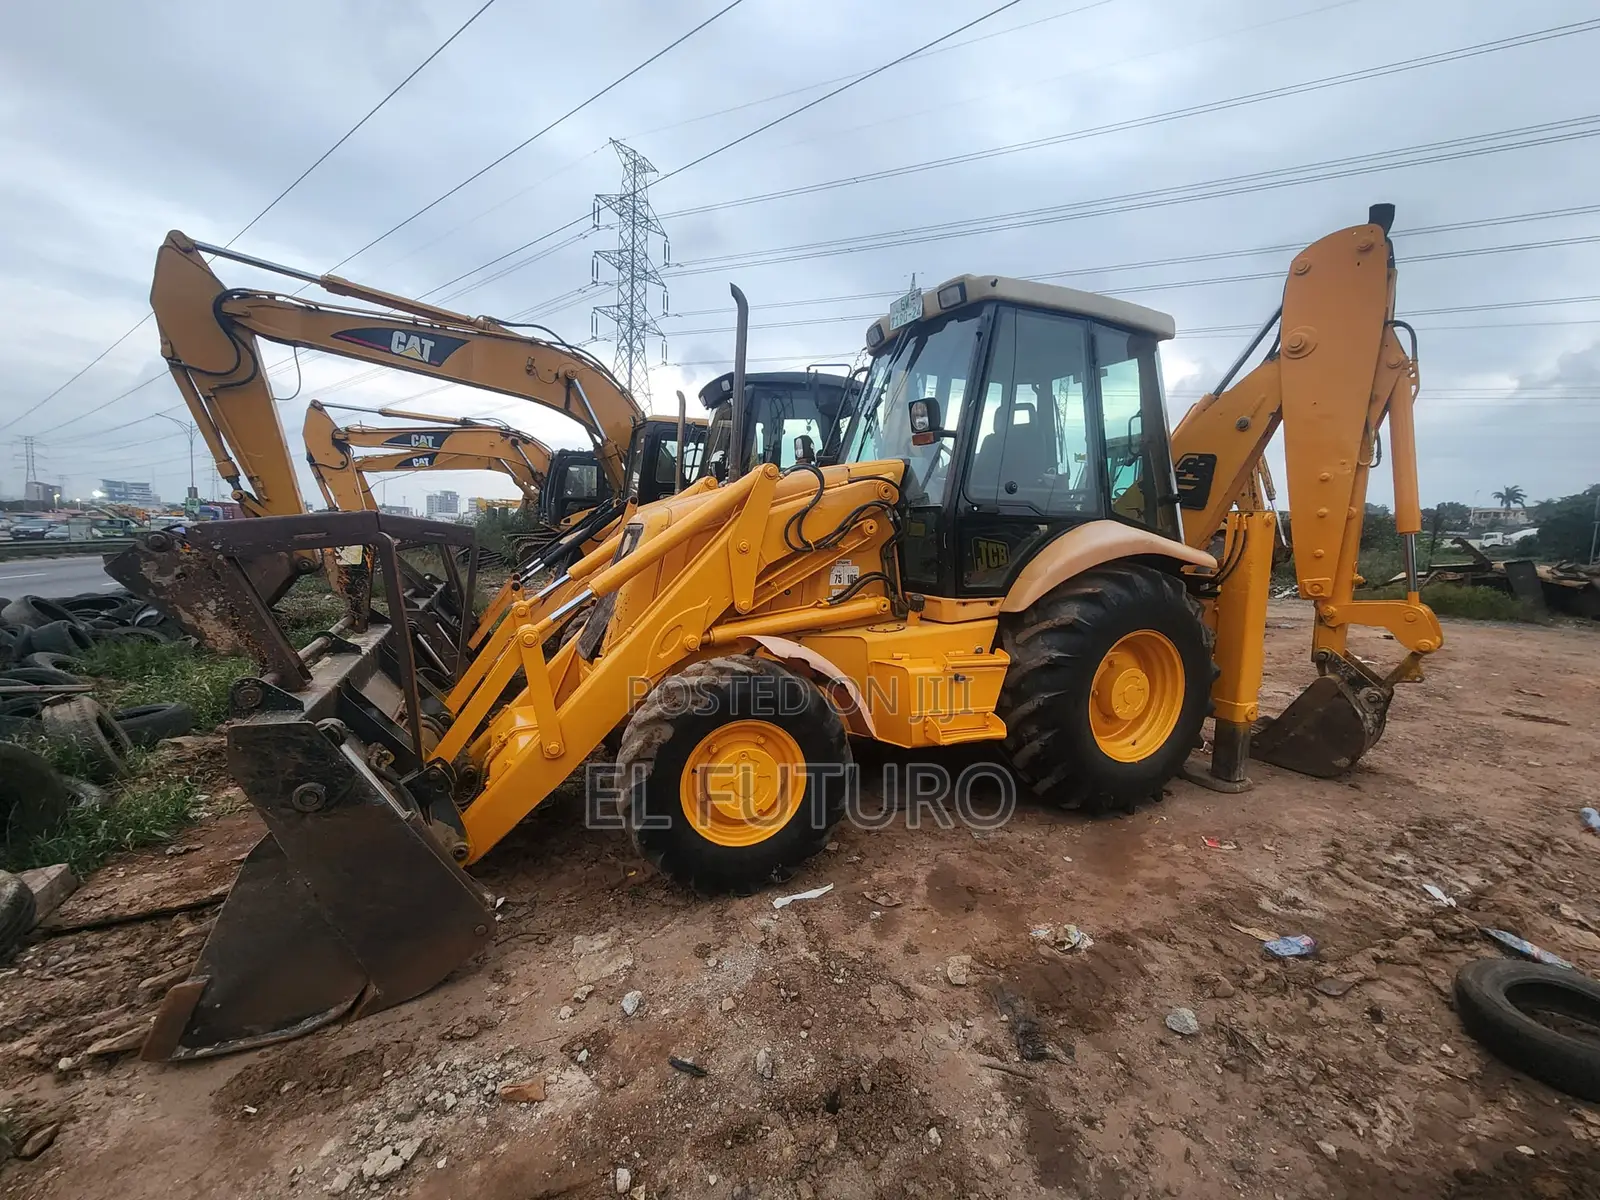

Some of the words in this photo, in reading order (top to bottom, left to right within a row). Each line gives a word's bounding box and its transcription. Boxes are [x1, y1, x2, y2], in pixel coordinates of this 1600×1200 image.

[390, 330, 435, 363] CAT
[410, 434, 435, 448] CAT
[412, 457, 430, 467] CAT
[976, 540, 1008, 571] JCB
[834, 573, 842, 584] 75
